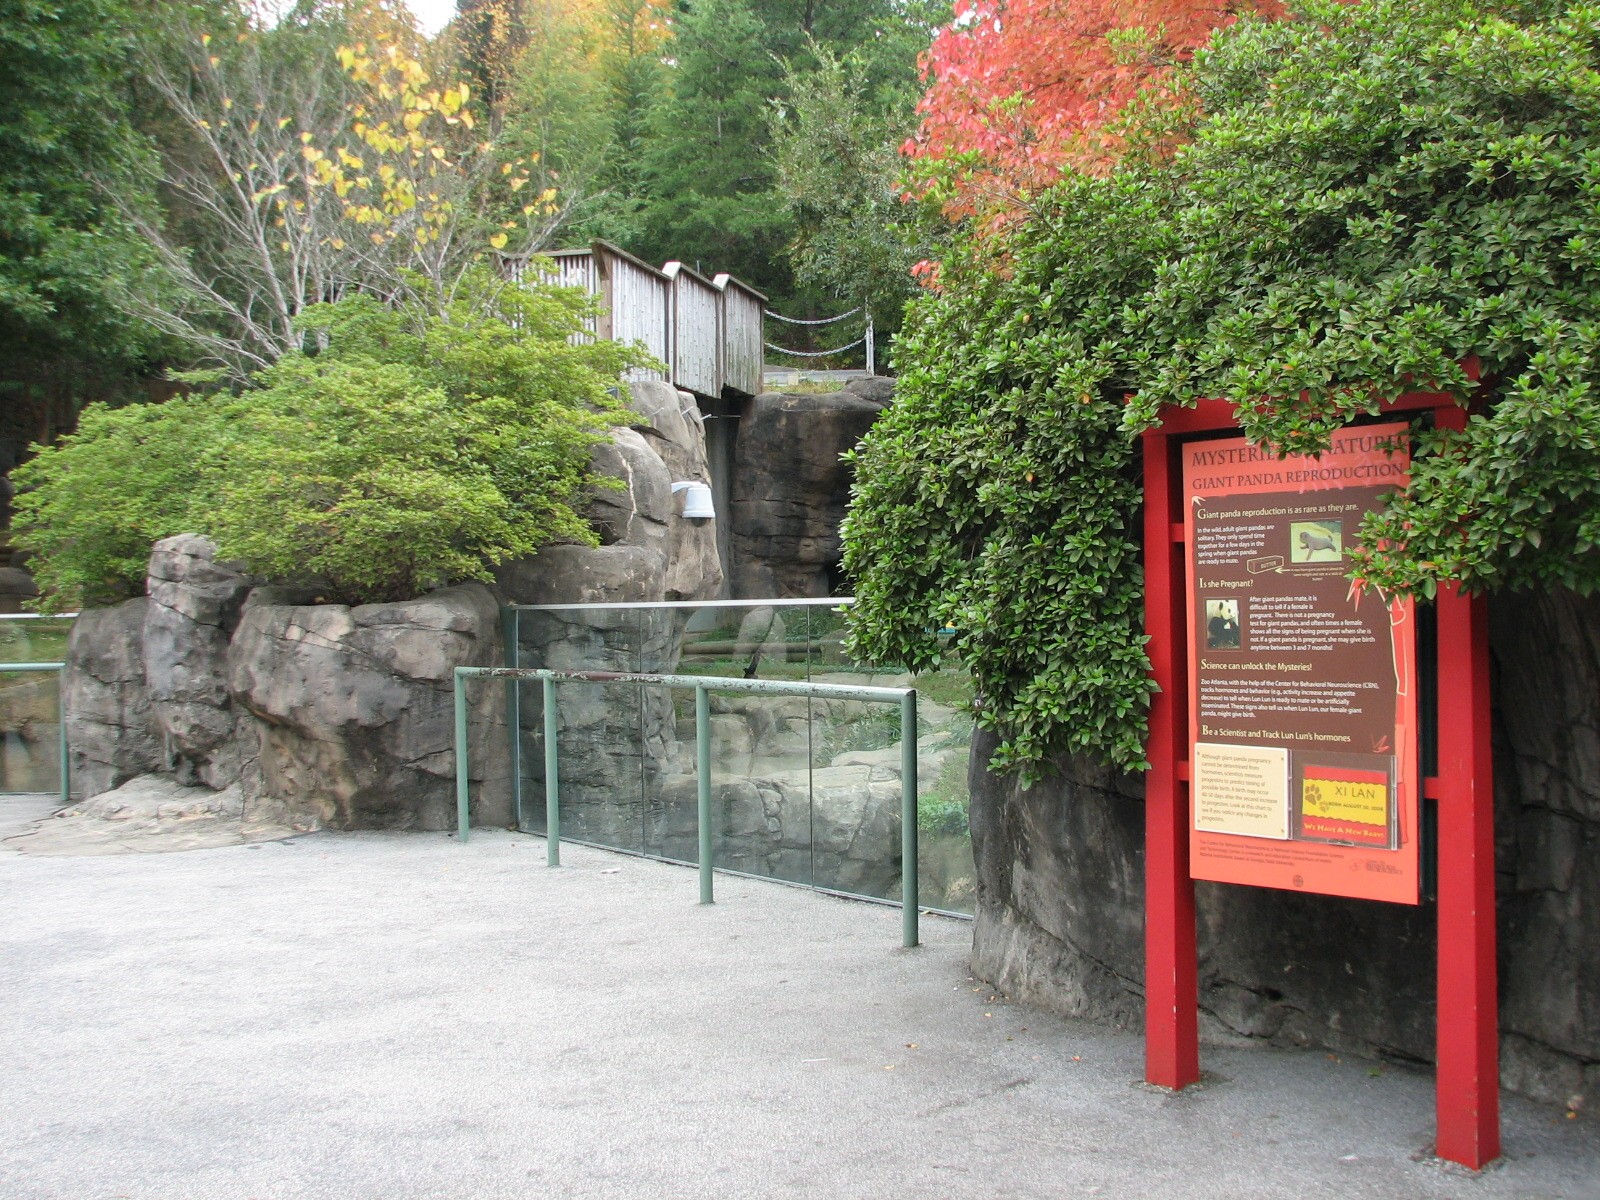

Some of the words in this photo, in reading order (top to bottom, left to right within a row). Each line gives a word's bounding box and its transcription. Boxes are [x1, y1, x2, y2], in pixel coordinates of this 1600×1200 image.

[1192, 447, 1281, 466] MYSTERIE
[1193, 476, 1234, 489] GIANT
[1238, 473, 1282, 486] PANDA
[1287, 463, 1403, 483] REPRODUCTION
[1198, 509, 1219, 519] Giant
[1220, 510, 1240, 519] panda
[1242, 508, 1286, 517] reproduction
[1199, 578, 1206, 588] Is
[1221, 579, 1253, 589] Pregnant?
[1201, 659, 1227, 670] Science
[1278, 663, 1312, 672] Mysteries!
[1202, 725, 1212, 735] Be
[1220, 728, 1246, 737] Scientist
[1263, 730, 1279, 738] Track
[1296, 732, 1313, 740] Lun's
[1314, 733, 1350, 742] hormones
[1335, 787, 1346, 796] XI
[1352, 787, 1375, 798] LAN
